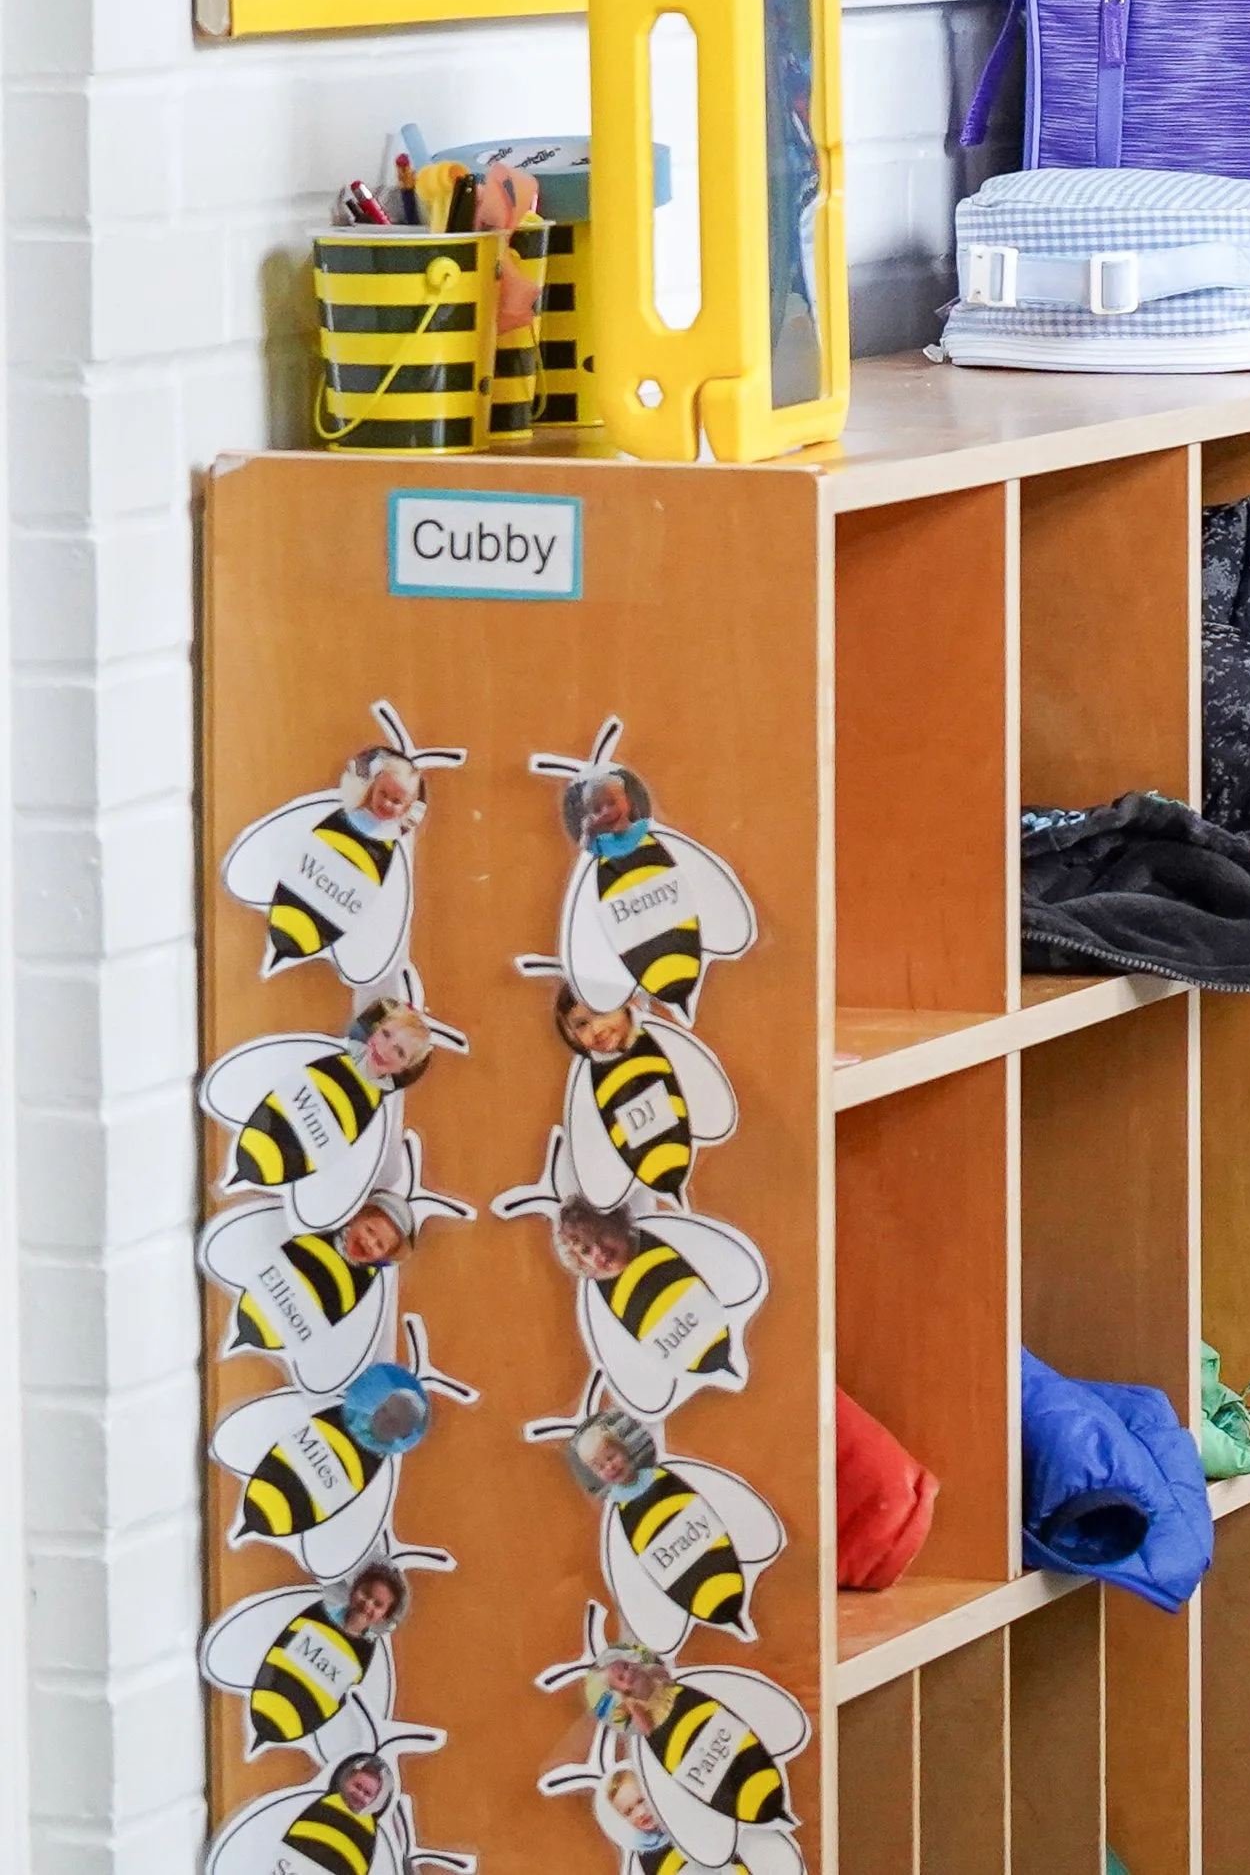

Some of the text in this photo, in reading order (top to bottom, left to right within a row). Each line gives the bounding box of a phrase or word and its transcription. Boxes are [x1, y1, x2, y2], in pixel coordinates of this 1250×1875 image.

[412, 519, 558, 574] Cubby
[297, 853, 364, 915] Wende
[609, 877, 680, 925] Benny
[291, 1085, 332, 1149] Winn
[626, 1104, 658, 1131] DJ
[257, 1265, 312, 1343] Ellison
[655, 1310, 700, 1361] Jude
[291, 1422, 341, 1490] Miles
[651, 1513, 712, 1572] Brady
[296, 1633, 343, 1682] Max
[686, 1724, 732, 1789] Paige
